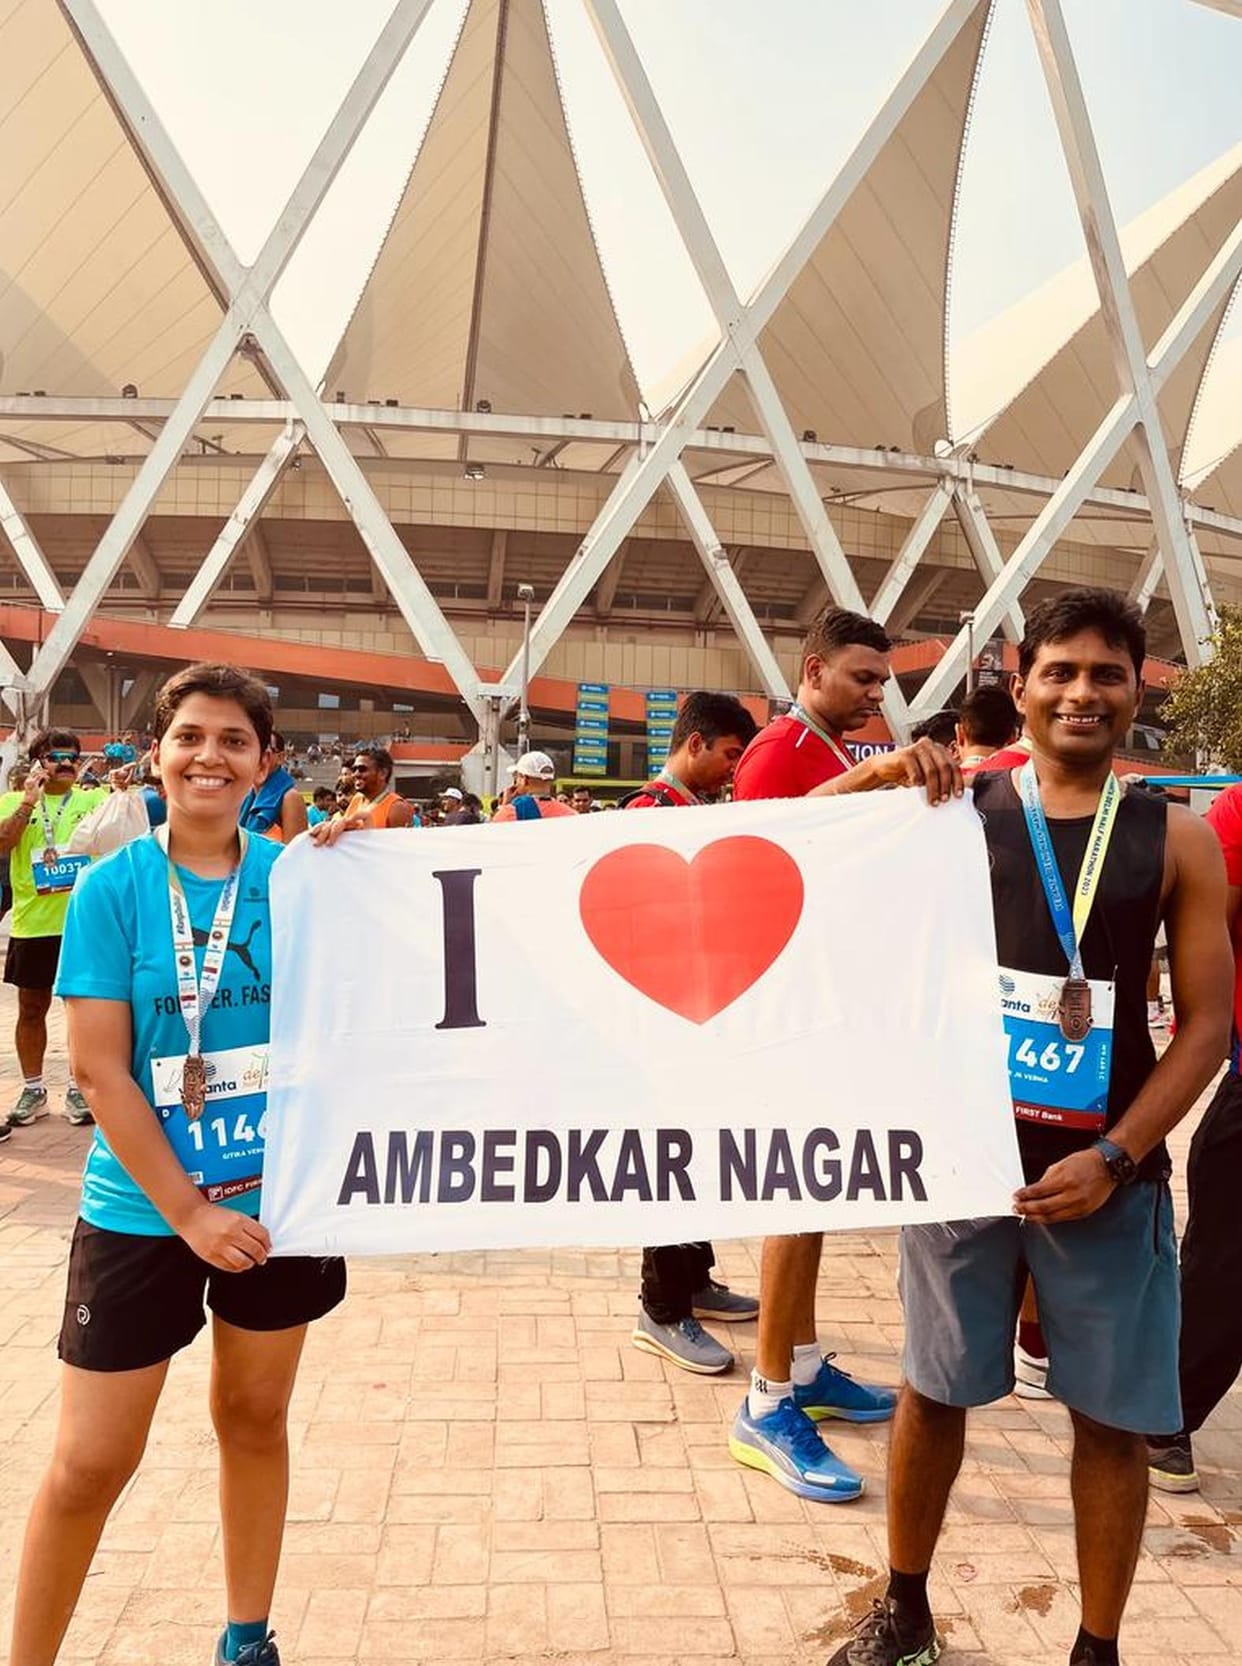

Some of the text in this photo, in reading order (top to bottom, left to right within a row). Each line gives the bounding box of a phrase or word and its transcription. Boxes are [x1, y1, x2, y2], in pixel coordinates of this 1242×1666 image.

[1086, 835, 1102, 876] MARATHON
[432, 868, 487, 1030] I
[1015, 1037, 1086, 1074] 467
[1015, 1106, 1063, 1122] FIRST Bank
[337, 1127, 929, 1206] AMBEDKAR NAGAR
